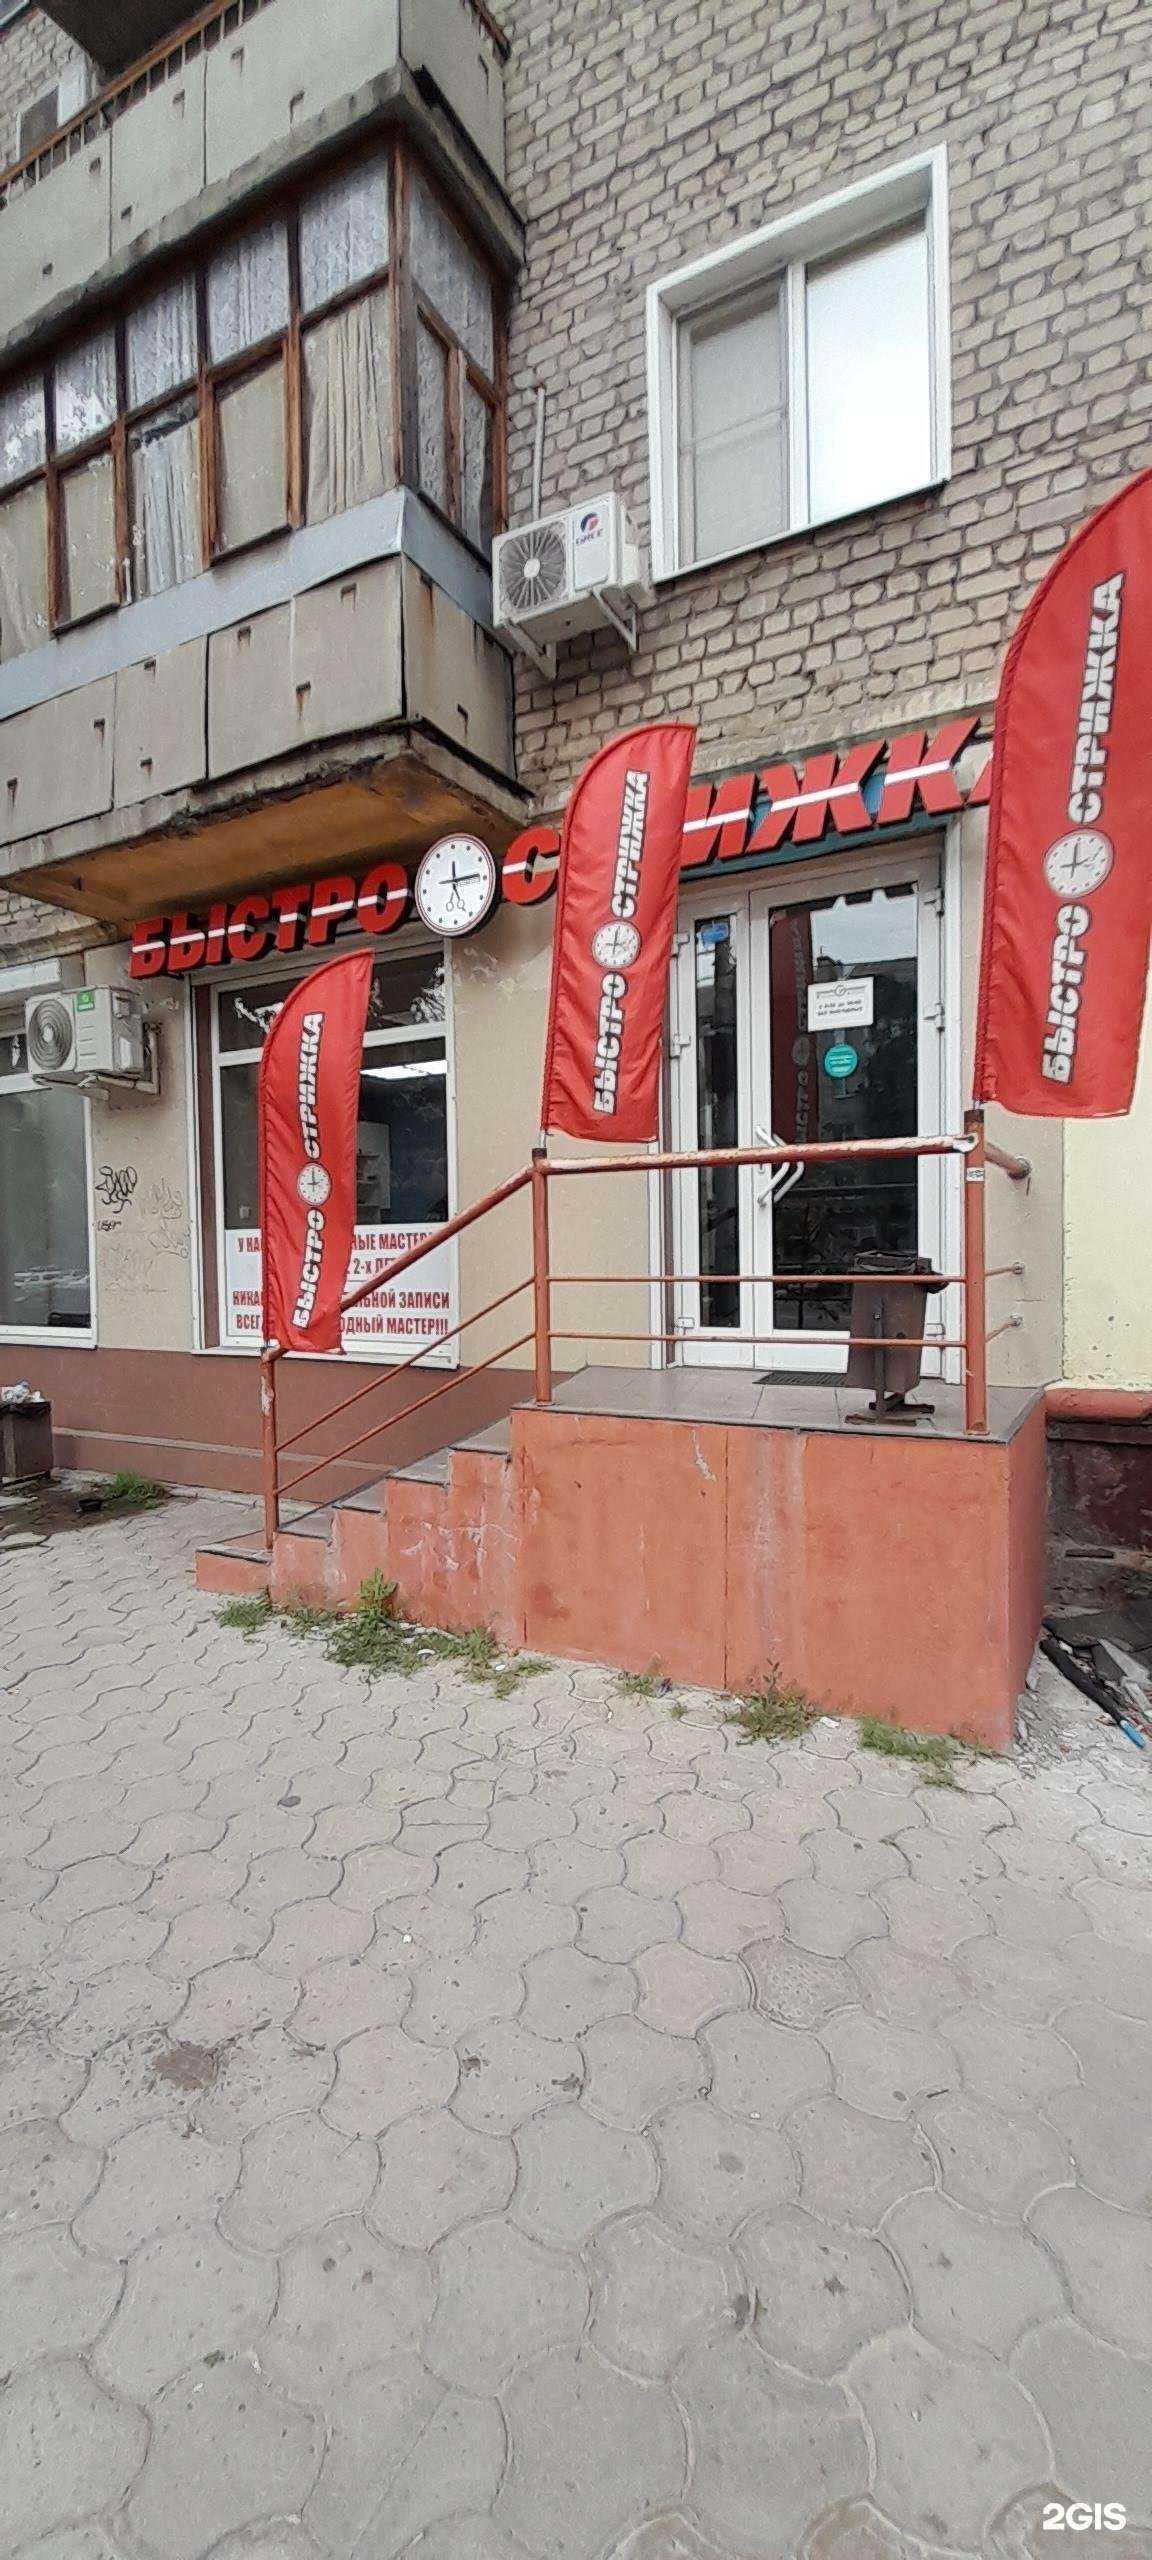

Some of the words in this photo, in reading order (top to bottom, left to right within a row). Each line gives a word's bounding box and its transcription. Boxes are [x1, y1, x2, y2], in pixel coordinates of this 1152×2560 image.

[1042, 901, 1091, 1085] БЫСТРО
[1067, 571, 1124, 825] СТРИЖКА
[129, 862, 411, 979] БЫСТРО
[593, 970, 627, 1115] БЫСТРО
[610, 770, 649, 919] СТРИЖКА
[298, 1012, 324, 1159] СТРИЖКА
[232, 1290, 260, 1305] НИКА
[399, 1291, 449, 1308] ЗАПИСИ
[237, 1238, 244, 1252] У
[246, 1237, 260, 1252] НА
[292, 1208, 325, 1329] БЫСТРО
[236, 1314, 260, 1329] ВСЕГ
[386, 1317, 449, 1335] МАСТЕР!!!
